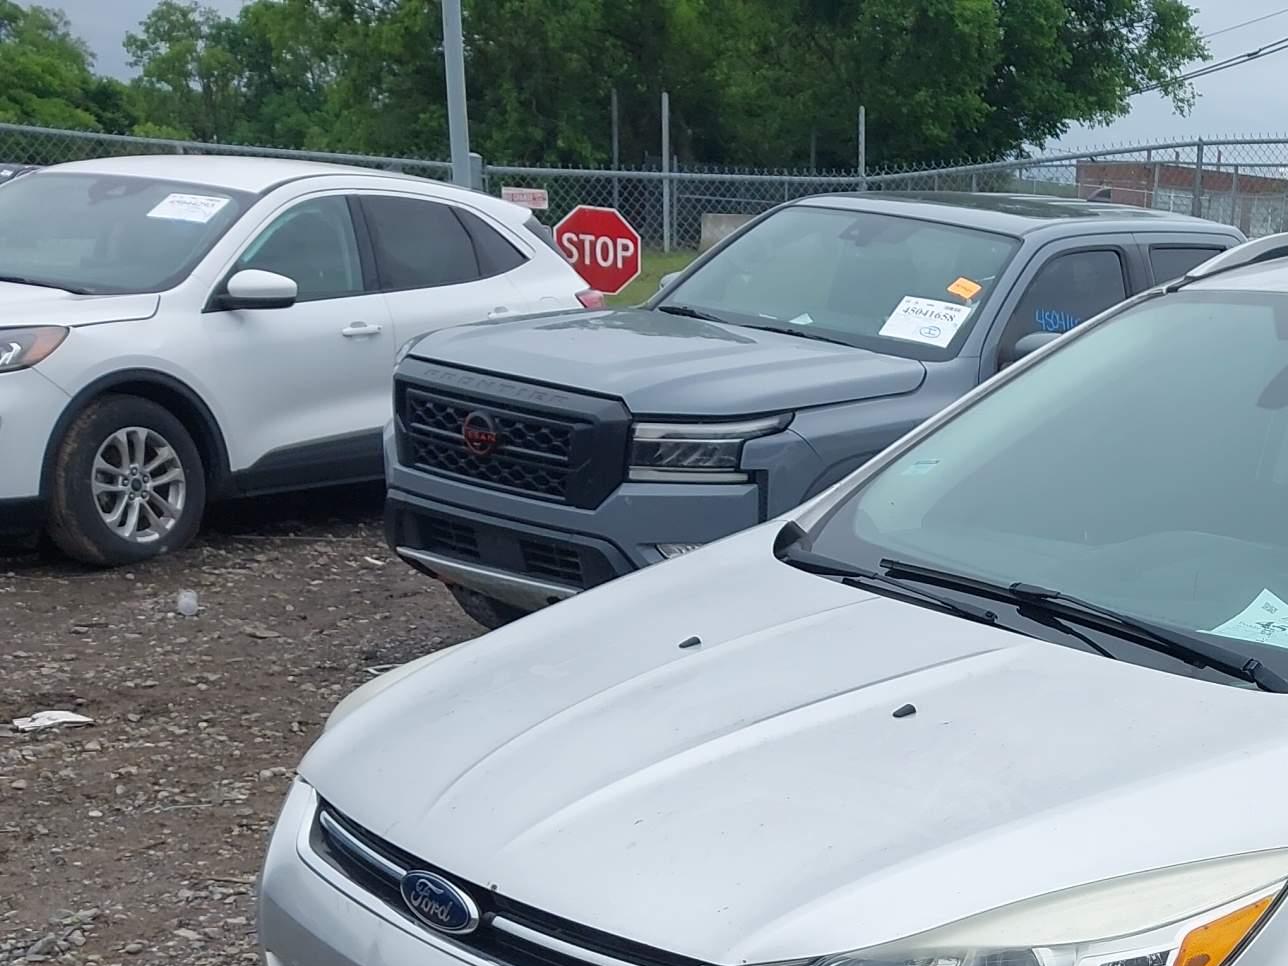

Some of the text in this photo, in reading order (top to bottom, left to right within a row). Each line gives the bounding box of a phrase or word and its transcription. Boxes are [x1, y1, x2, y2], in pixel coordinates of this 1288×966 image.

[561, 232, 635, 270] STOP
[902, 306, 957, 323] 45041658
[424, 368, 570, 406] FRONTIER
[411, 879, 453, 921] Ford
